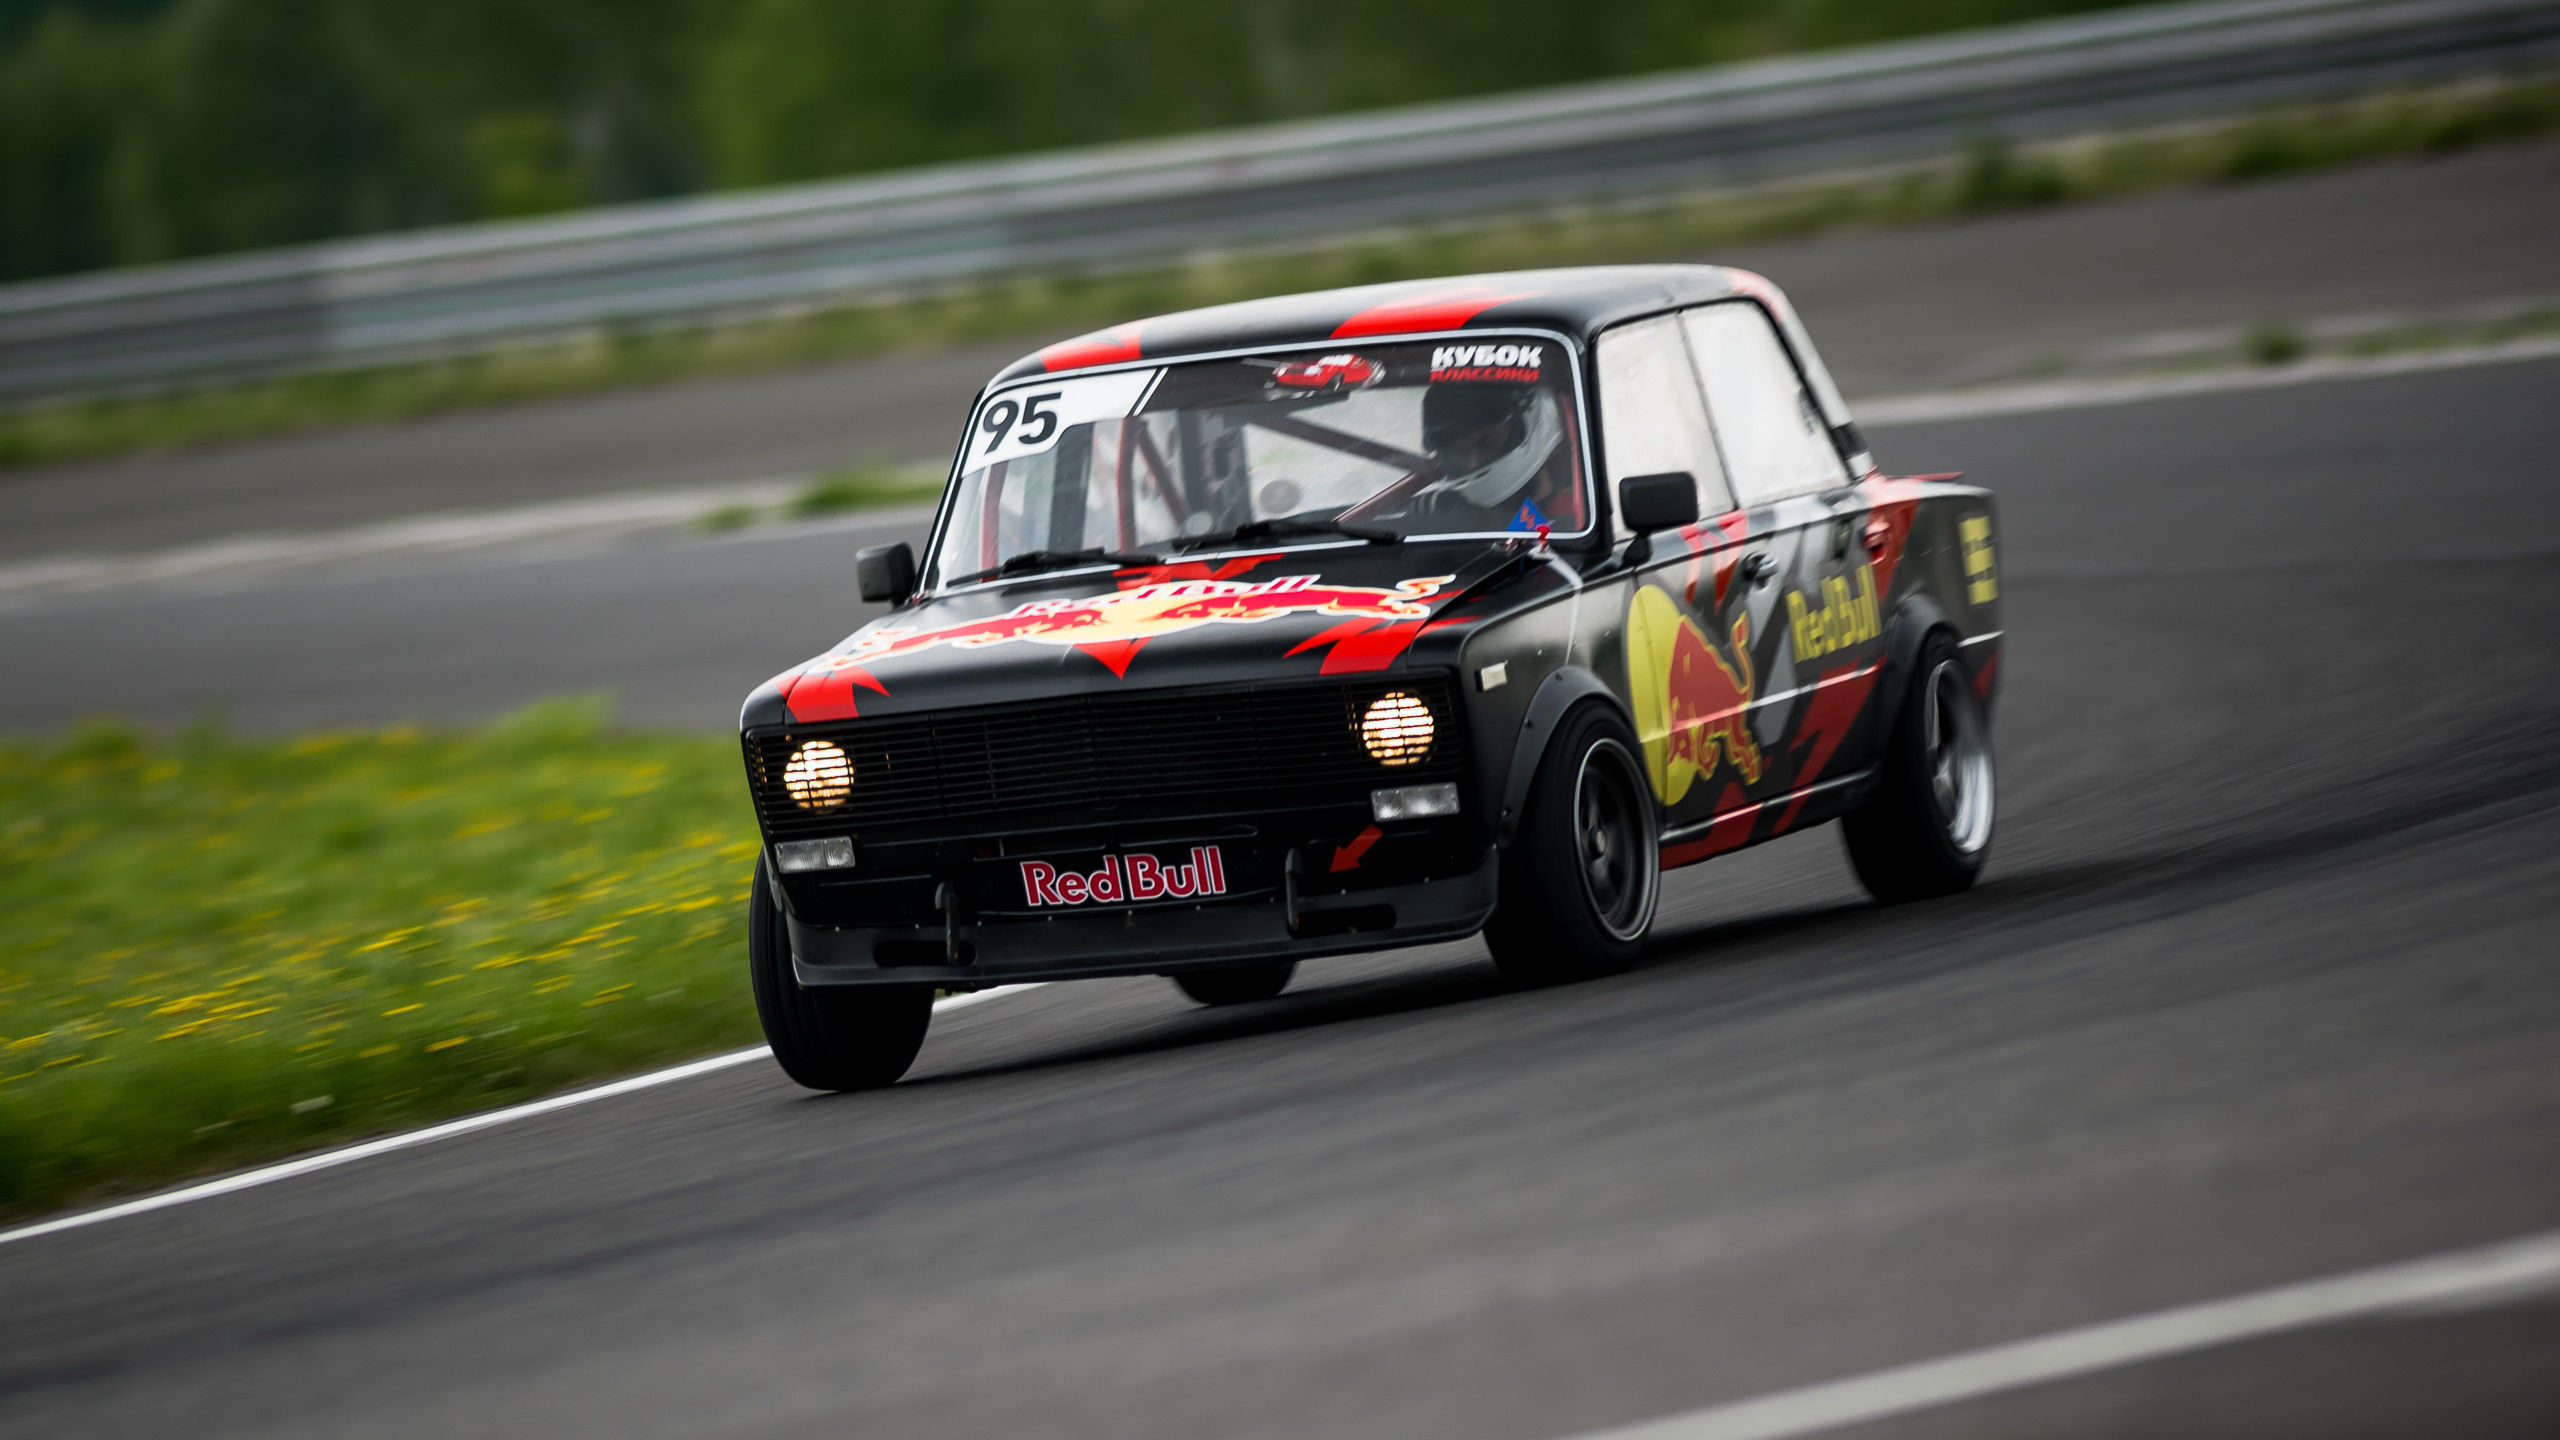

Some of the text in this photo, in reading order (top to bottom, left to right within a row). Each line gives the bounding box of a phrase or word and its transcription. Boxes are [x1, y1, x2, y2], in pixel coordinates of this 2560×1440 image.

[1430, 345, 1543, 371] КУБОК
[983, 391, 1063, 455] 95
[1784, 563, 1882, 664] Red Bull
[1020, 846, 1226, 906] Red Bull
